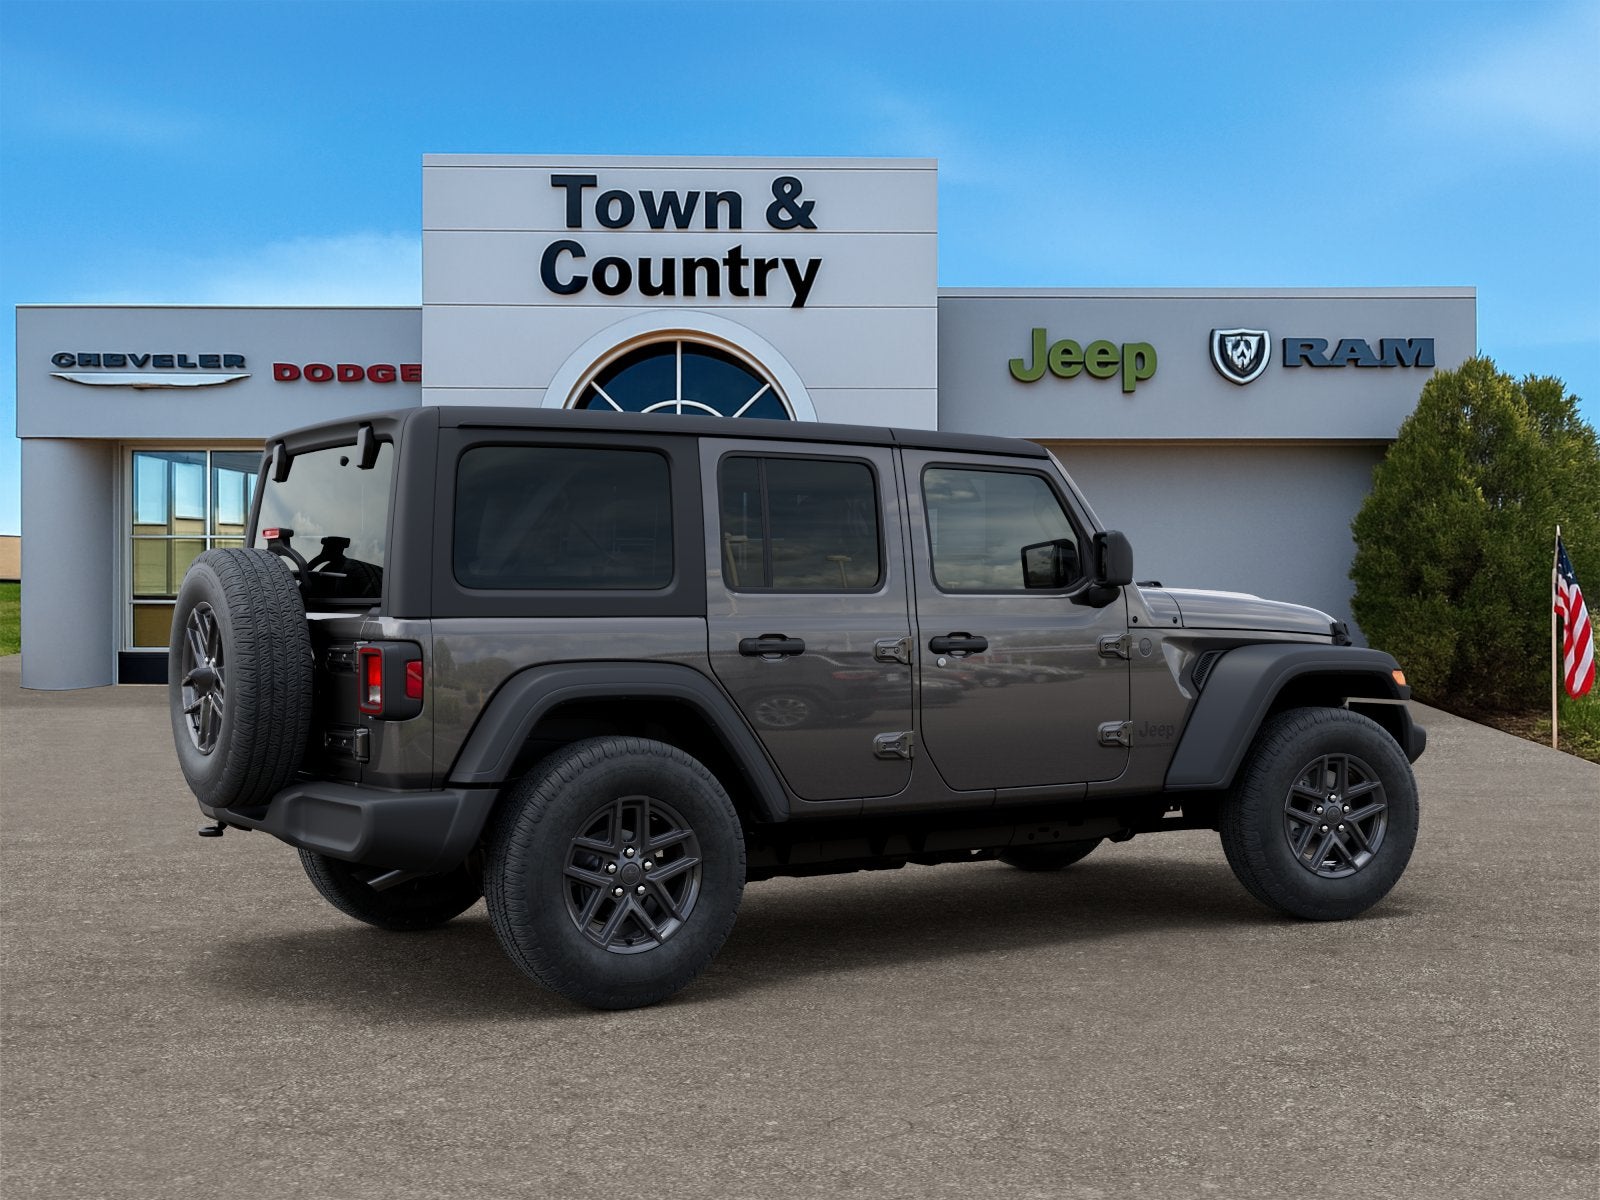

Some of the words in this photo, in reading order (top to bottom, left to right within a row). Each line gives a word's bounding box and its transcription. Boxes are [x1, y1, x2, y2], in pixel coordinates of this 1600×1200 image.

[550, 174, 742, 229] Town
[765, 175, 818, 230] &
[540, 239, 822, 308] Country
[272, 362, 422, 383] DODGE
[1008, 327, 1158, 393] Jeep
[1282, 337, 1435, 368] RAM
[1138, 721, 1175, 739] Jeep
